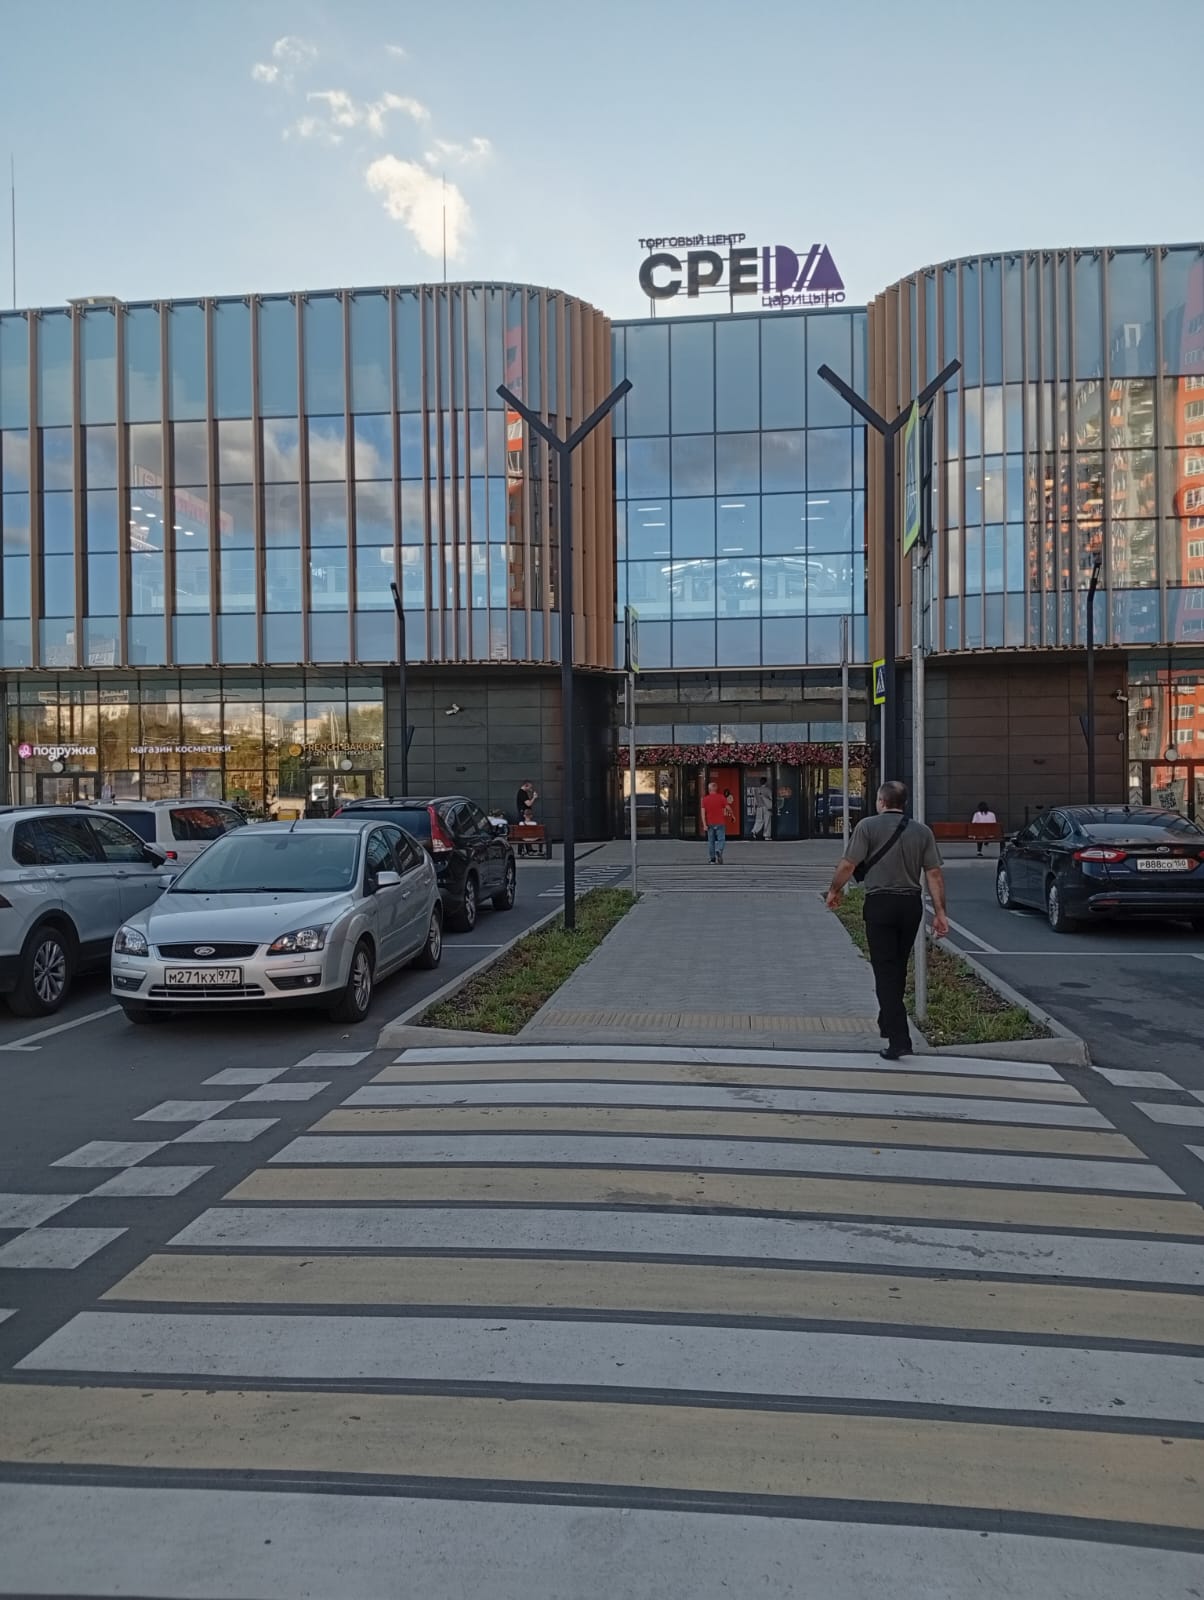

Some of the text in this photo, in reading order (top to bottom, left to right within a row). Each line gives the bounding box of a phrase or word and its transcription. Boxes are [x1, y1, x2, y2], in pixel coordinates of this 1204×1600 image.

[638, 233, 746, 249] ТОРГОВЫЙ ЦЕНТР
[130, 745, 232, 754] магазин косметики
[303, 743, 380, 751] FRENCH BAKERY
[33, 746, 97, 761] подружка
